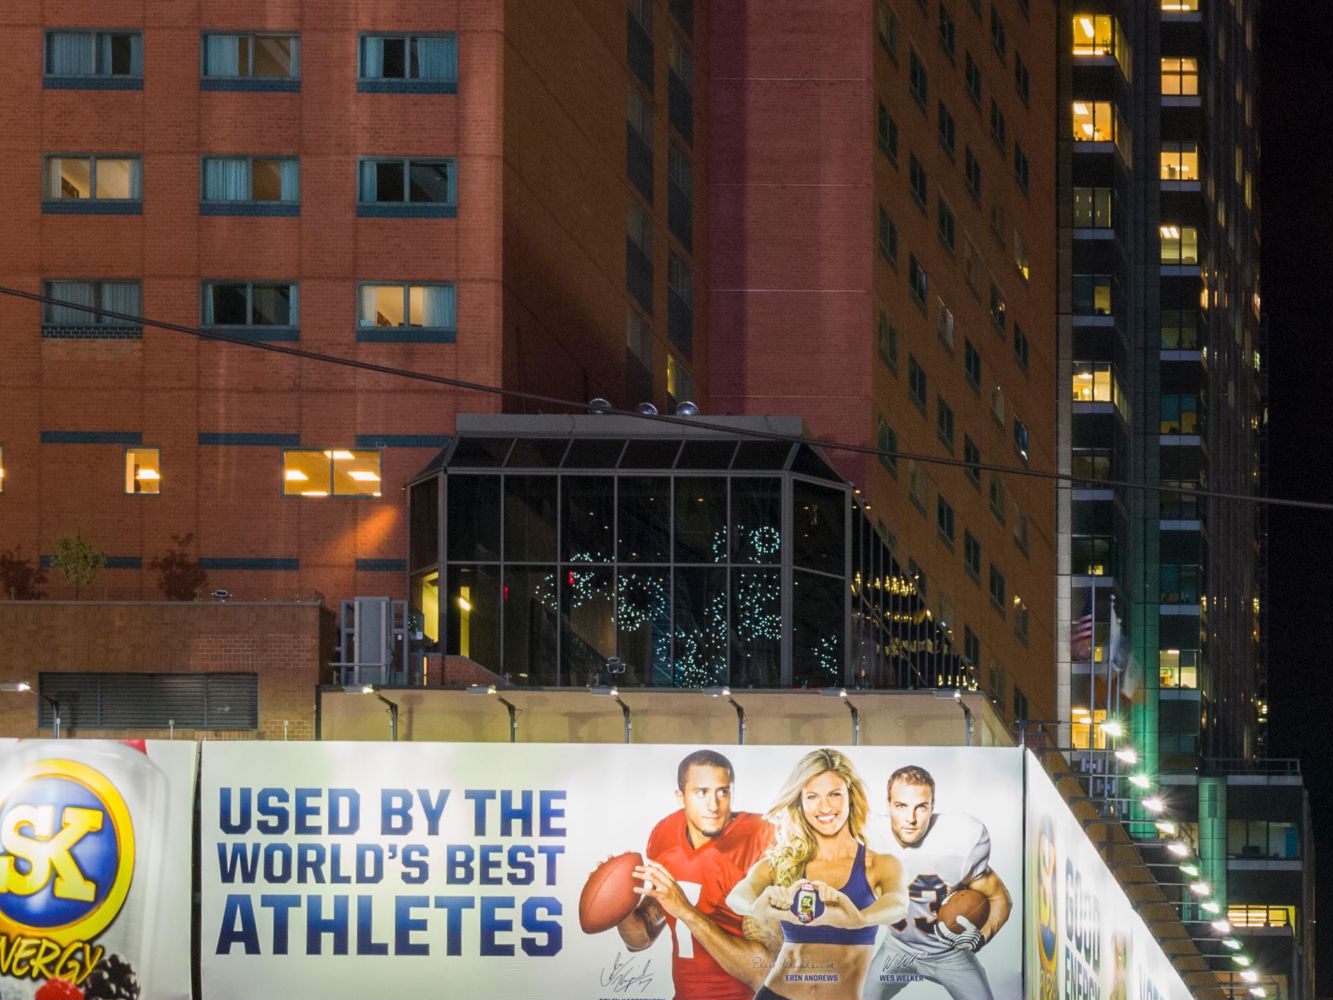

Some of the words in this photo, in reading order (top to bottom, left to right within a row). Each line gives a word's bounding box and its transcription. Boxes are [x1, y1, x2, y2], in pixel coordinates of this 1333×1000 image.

[218, 787, 361, 837] USED
[380, 787, 451, 837] BY
[464, 788, 568, 838] THE
[0, 804, 104, 903] SK
[217, 843, 430, 886] WORLD'S
[447, 844, 567, 887] BEST
[215, 894, 565, 959] ATHLETES
[1065, 856, 1100, 977] GOOD
[0, 936, 103, 986] NERGY
[785, 974, 802, 982] ERIN
[804, 974, 838, 982] ANDREWS
[879, 974, 893, 982] WES
[894, 975, 924, 983] WELKER
